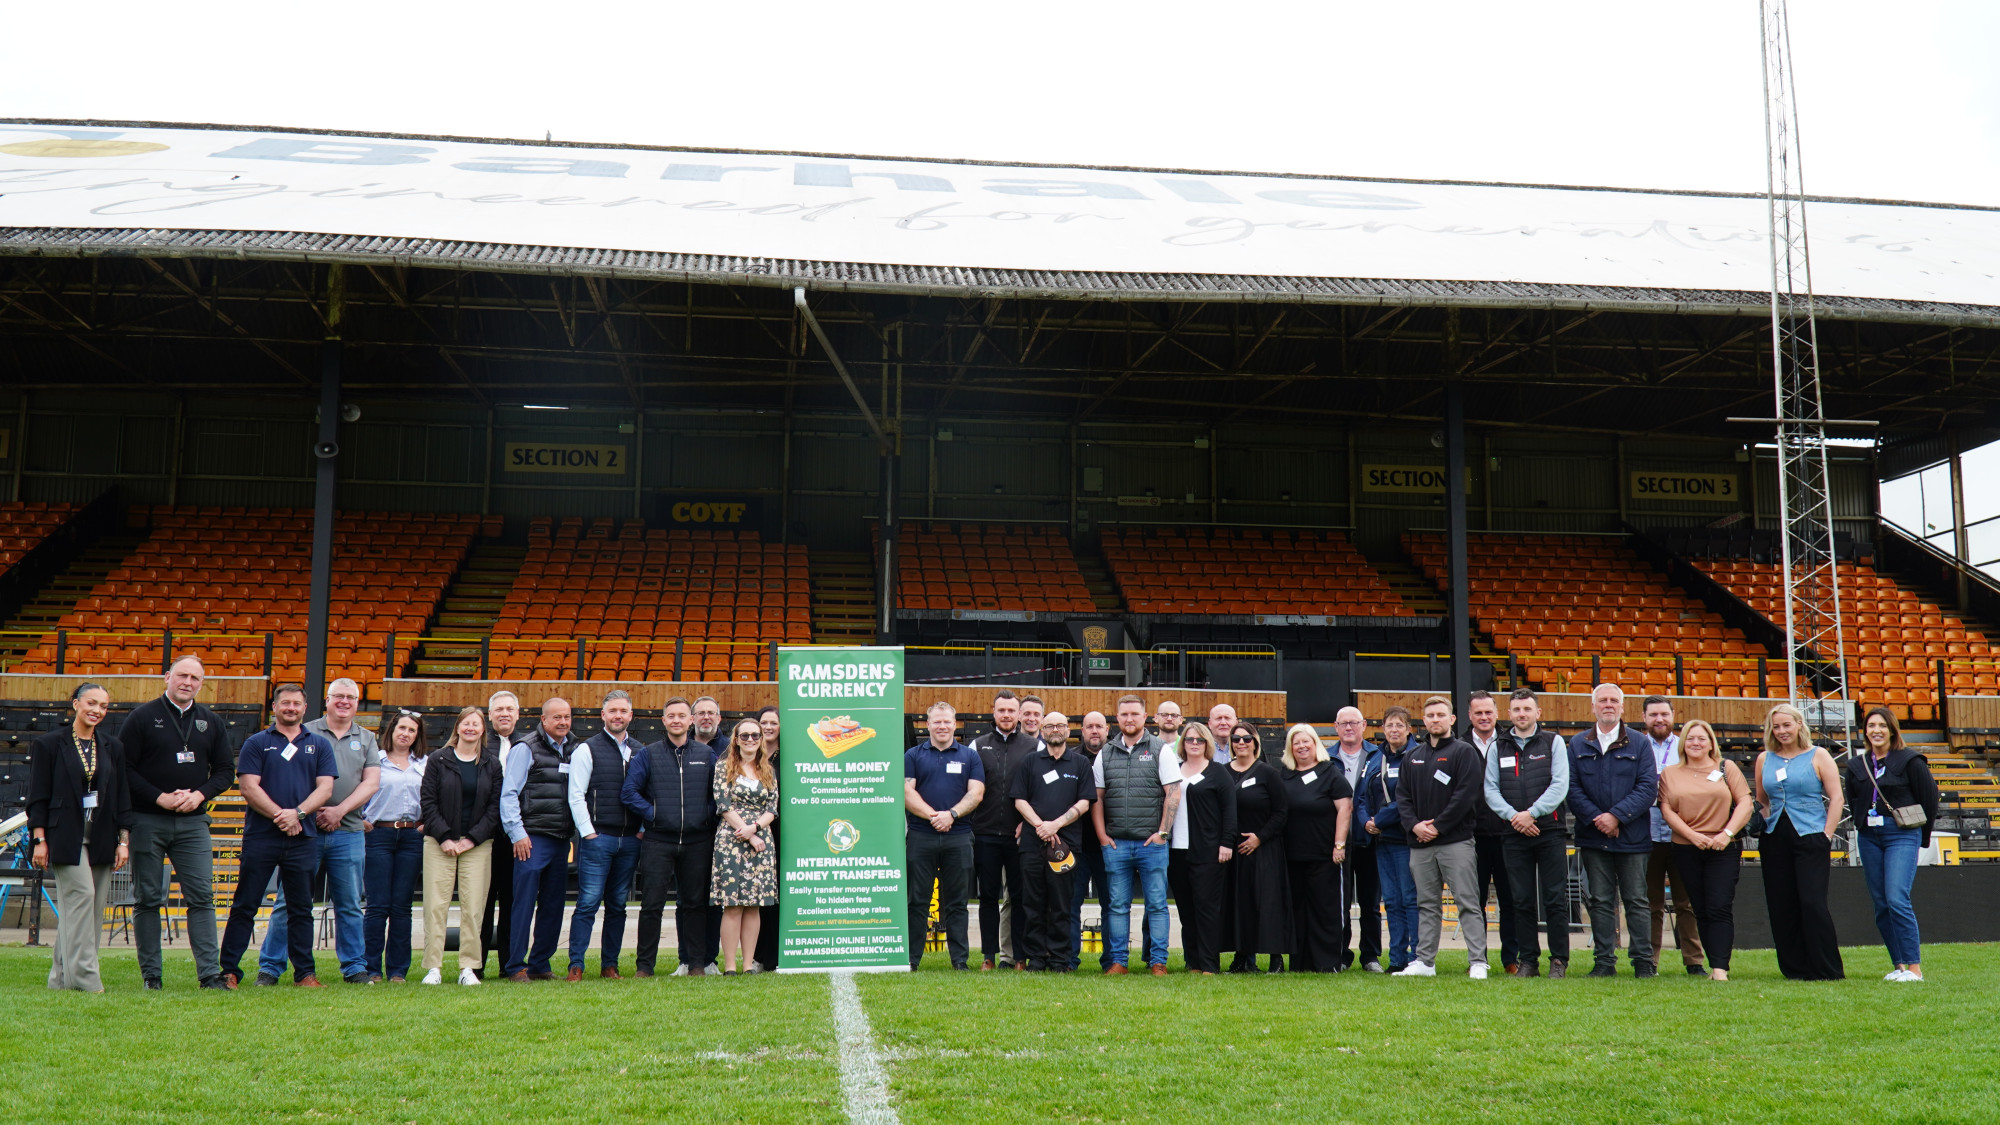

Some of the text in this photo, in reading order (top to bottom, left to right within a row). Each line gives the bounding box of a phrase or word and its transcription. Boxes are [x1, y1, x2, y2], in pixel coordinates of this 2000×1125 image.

[207, 137, 1427, 211] Barhale
[512, 448, 618, 468] SECTION 2
[1368, 469, 1447, 487] SECTION
[1637, 476, 1732, 496] SECTION 3
[671, 502, 746, 523] COYF
[789, 664, 895, 680] RAMSDENS
[797, 682, 887, 697] CURRENCY
[795, 762, 890, 772] TRAVEL MONEY
[800, 776, 821, 784] Great
[843, 776, 885, 785] guaranteed
[811, 786, 858, 794] Commission
[790, 797, 809, 805] Over
[862, 795, 895, 803] available
[796, 856, 890, 867] INTERNATIONAL
[786, 869, 901, 881] MONEY TRANSFERS
[789, 884, 898, 895] Easily transfer money abroad
[828, 896, 854, 904] hidden
[797, 907, 832, 915] Excellent
[833, 907, 870, 915] exchange
[785, 938, 794, 946] IN
[795, 937, 830, 946] BRANCH
[835, 936, 865, 944] ONLINE
[871, 935, 902, 944] MOBILE
[783, 945, 904, 956] www.RAMSDENSCURRENCY.co.uk
